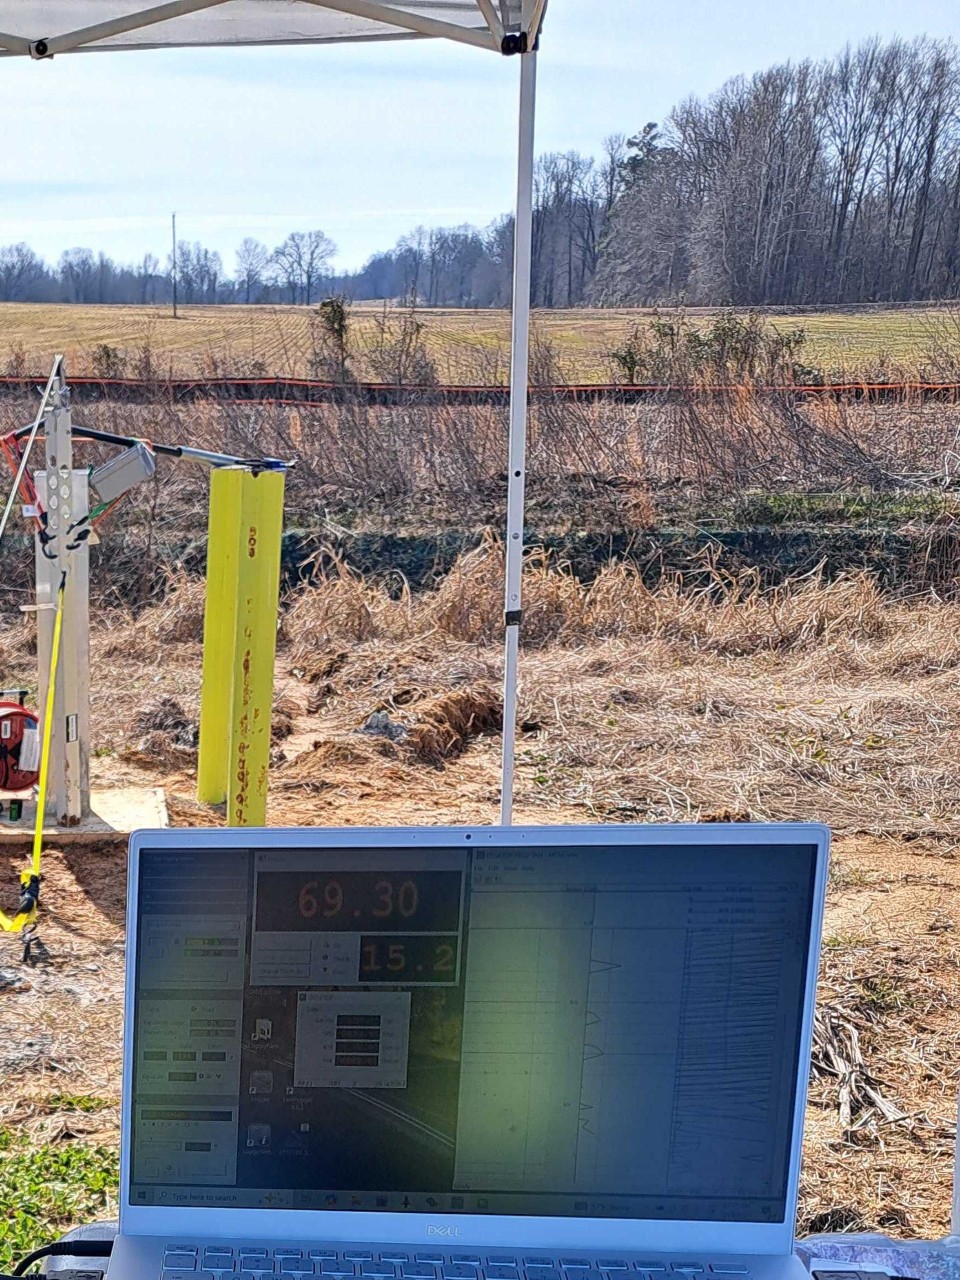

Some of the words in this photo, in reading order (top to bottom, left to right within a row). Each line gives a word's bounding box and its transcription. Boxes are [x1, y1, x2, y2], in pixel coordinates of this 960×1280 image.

[298, 880, 418, 918] 69.30
[363, 944, 454, 971] 15.2
[172, 1193, 189, 1202] Type
[427, 1225, 462, 1236] DELL
